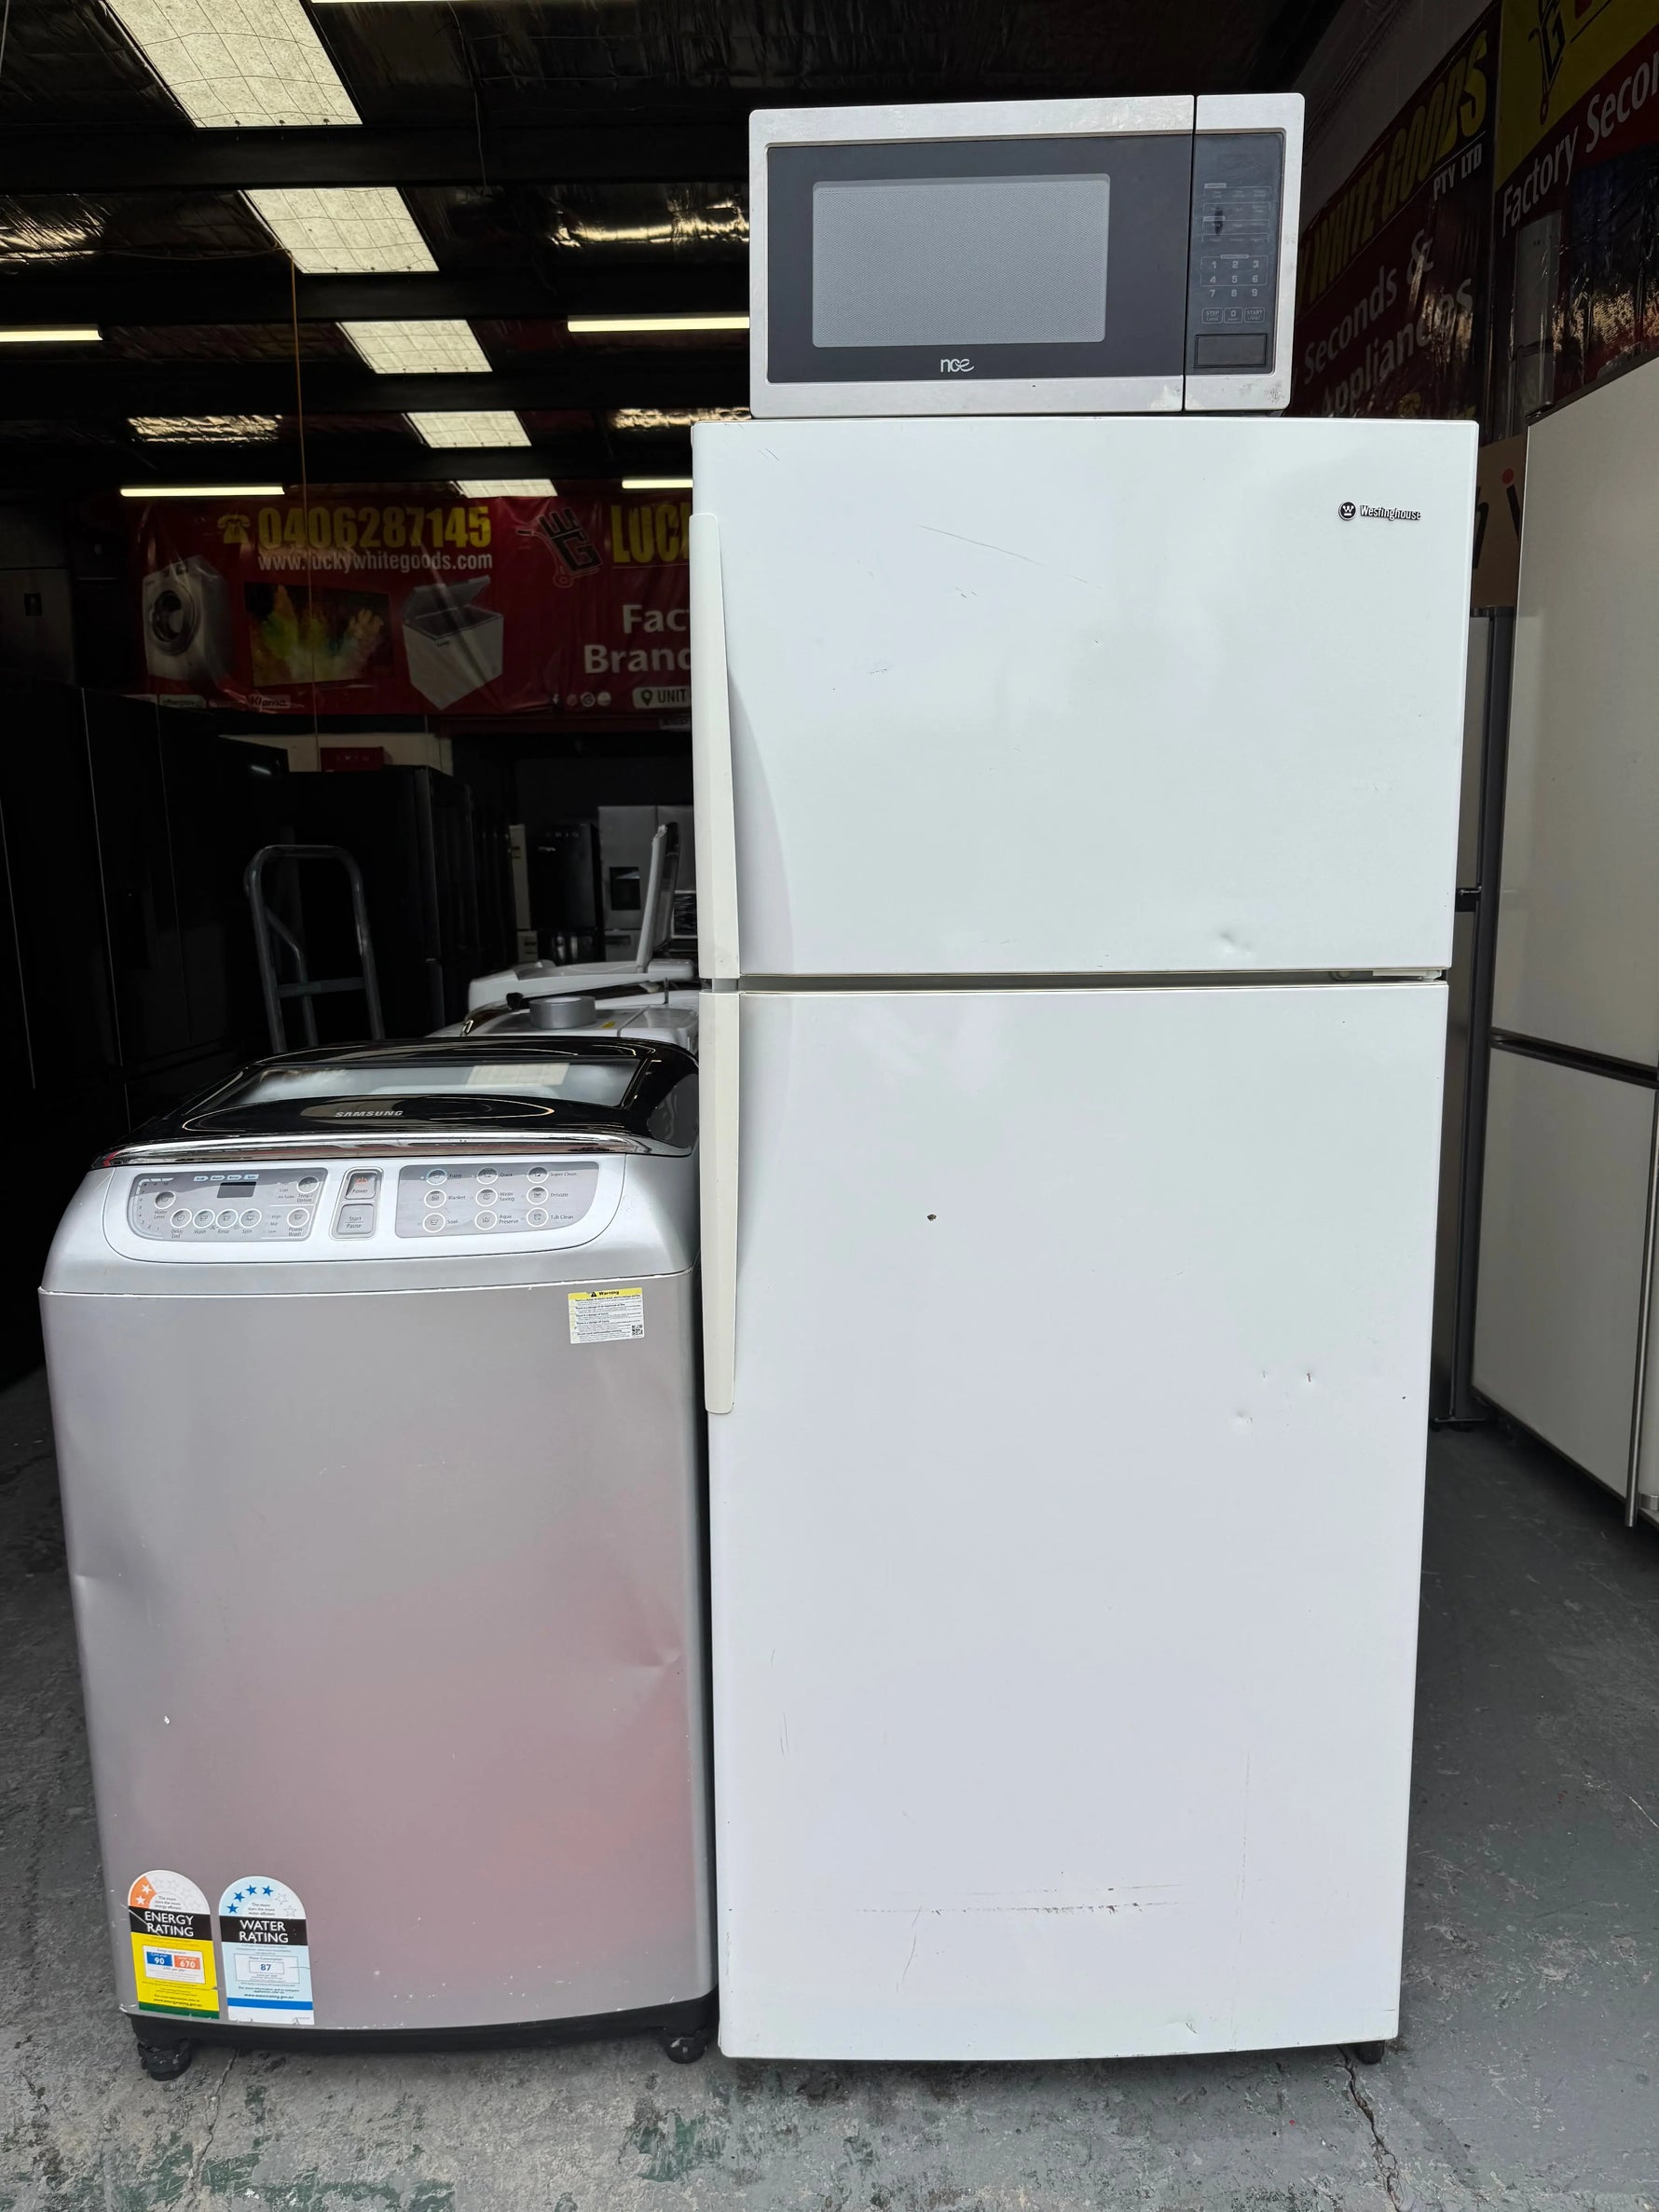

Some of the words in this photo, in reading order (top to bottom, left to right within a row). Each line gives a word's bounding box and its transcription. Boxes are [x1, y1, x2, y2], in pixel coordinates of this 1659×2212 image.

[1380, 28, 1488, 225] GOODS
[1433, 162, 1457, 201] PTY
[1460, 142, 1483, 180] LTD
[1502, 126, 1579, 239] Factory
[1305, 264, 1398, 385] Seconds
[1406, 228, 1434, 286] &
[1360, 504, 1422, 521] Westinghouse
[257, 506, 492, 550] 0406287145
[257, 551, 493, 574] www.uckywhitegoods.com
[622, 604, 690, 635] Fac
[657, 689, 687, 704] UNIT
[144, 1911, 194, 1926] ENERGY
[240, 1919, 286, 1931] WATER
[147, 1922, 195, 1937] RATING
[239, 1930, 289, 1944] RATING
[154, 1957, 165, 1965] 90
[180, 1959, 196, 1968] 670
[260, 1963, 272, 1972] 87
